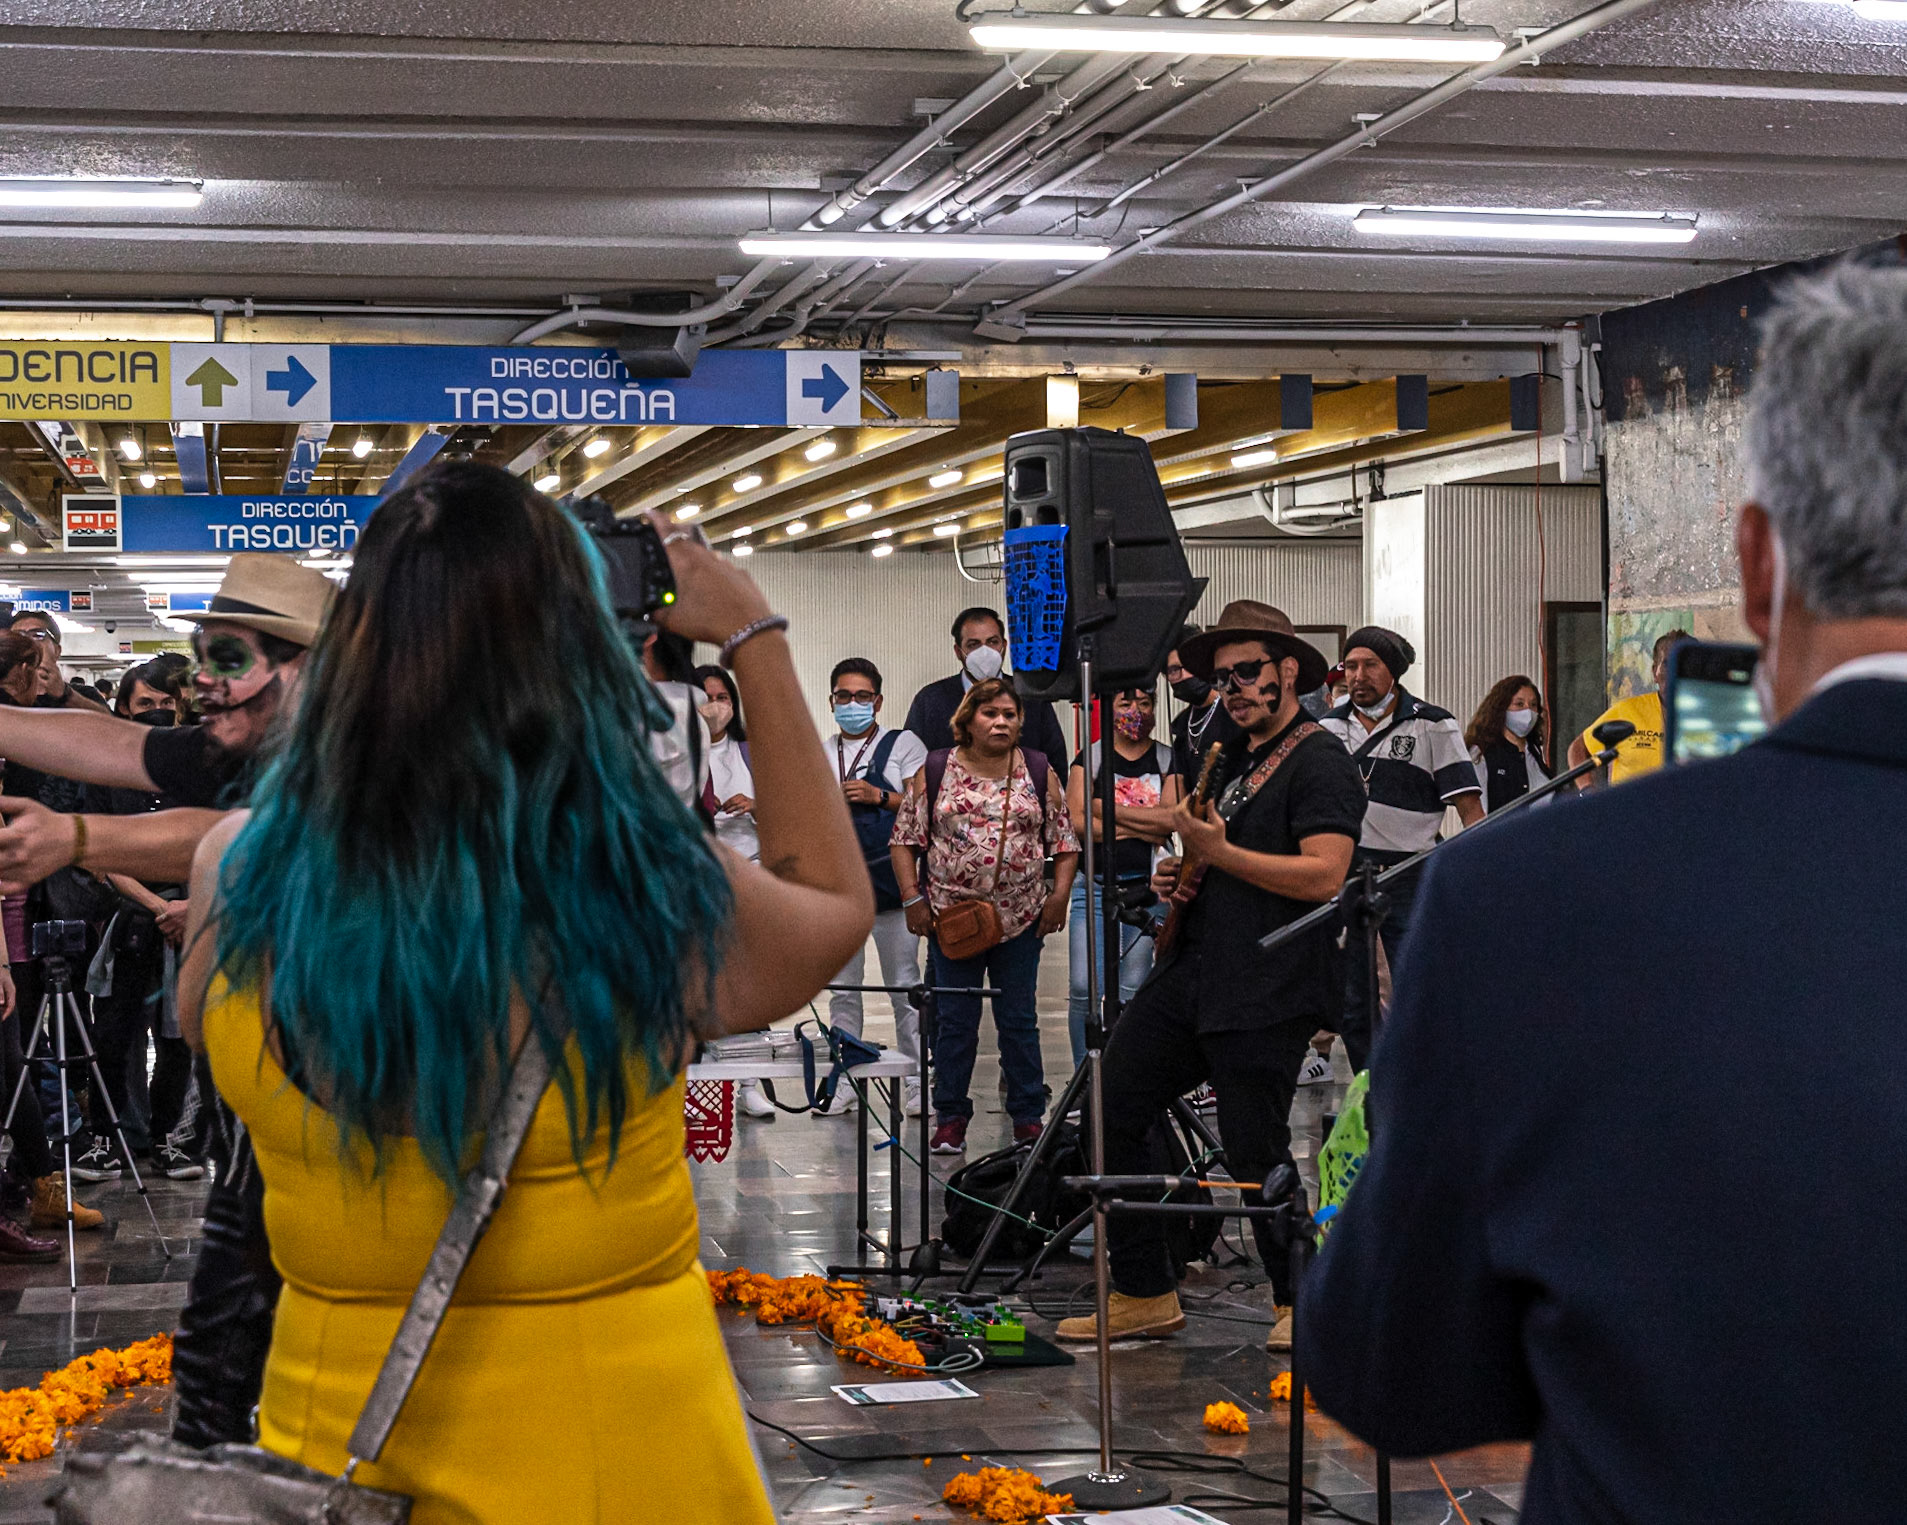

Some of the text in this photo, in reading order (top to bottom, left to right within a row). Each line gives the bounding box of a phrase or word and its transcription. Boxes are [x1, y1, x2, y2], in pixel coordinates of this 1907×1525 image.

[0, 350, 158, 383] DENCIA
[491, 352, 629, 379] DIRECCIÓN
[0, 393, 132, 410] NIVERSIDAD
[444, 382, 676, 421] TASQUEÑA
[242, 498, 347, 518] DIRECCIÓN
[207, 519, 360, 549] TASQUEÑ
[13, 600, 61, 611] AMINOS
